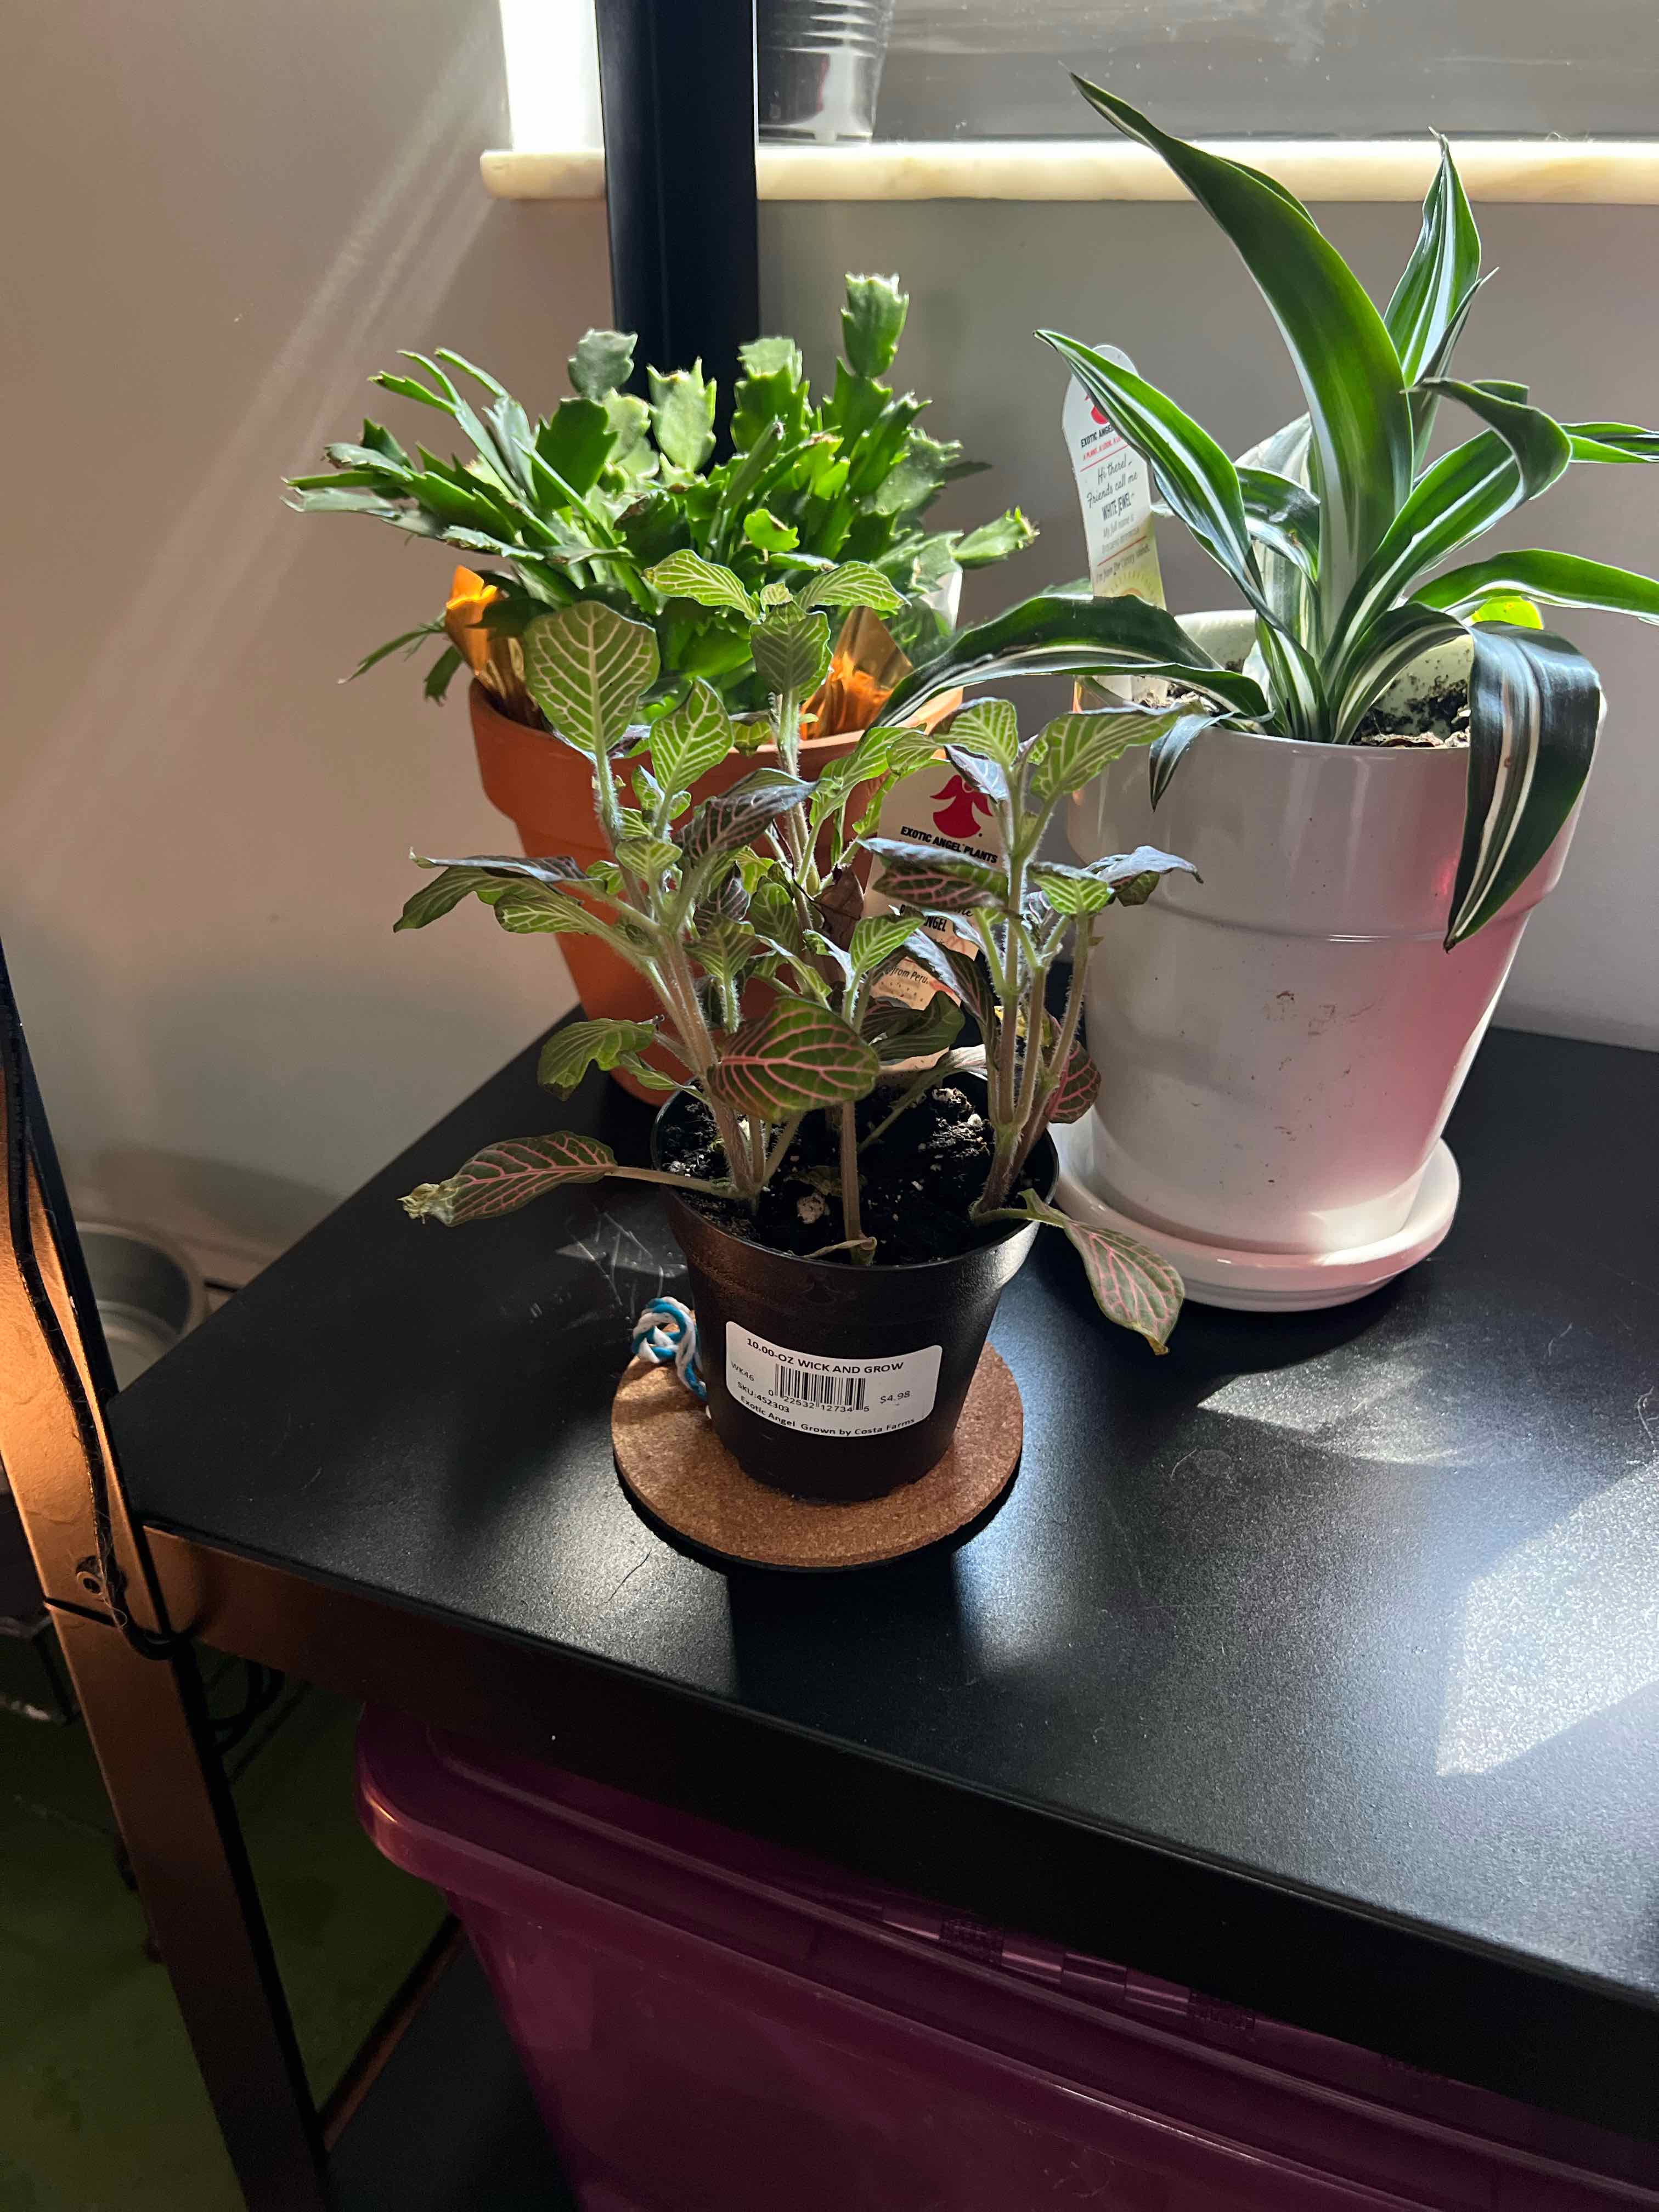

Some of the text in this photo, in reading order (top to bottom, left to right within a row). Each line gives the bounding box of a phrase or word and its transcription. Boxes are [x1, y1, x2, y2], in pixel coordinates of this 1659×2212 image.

[1081, 432, 1098, 448] EXOTIC
[1097, 466, 1107, 485] Hi
[1087, 472, 1138, 509] Friends call me
[1102, 500, 1118, 521] WHITE
[1118, 492, 1131, 516] JEWEL
[900, 826, 998, 863] EXOTIC ANGEL PLANTS
[924, 916, 947, 932] NGEL
[747, 1338, 904, 1374] 10.00-OZ WICK AND GROW
[783, 1396, 815, 1409] 22532
[822, 1404, 854, 1413] 12734
[880, 1391, 911, 1404] $4.98
[740, 1396, 766, 1415] Exotic
[768, 1413, 795, 1426] Angel
[801, 1424, 836, 1435] Grown
[887, 1418, 915, 1430] Farms
